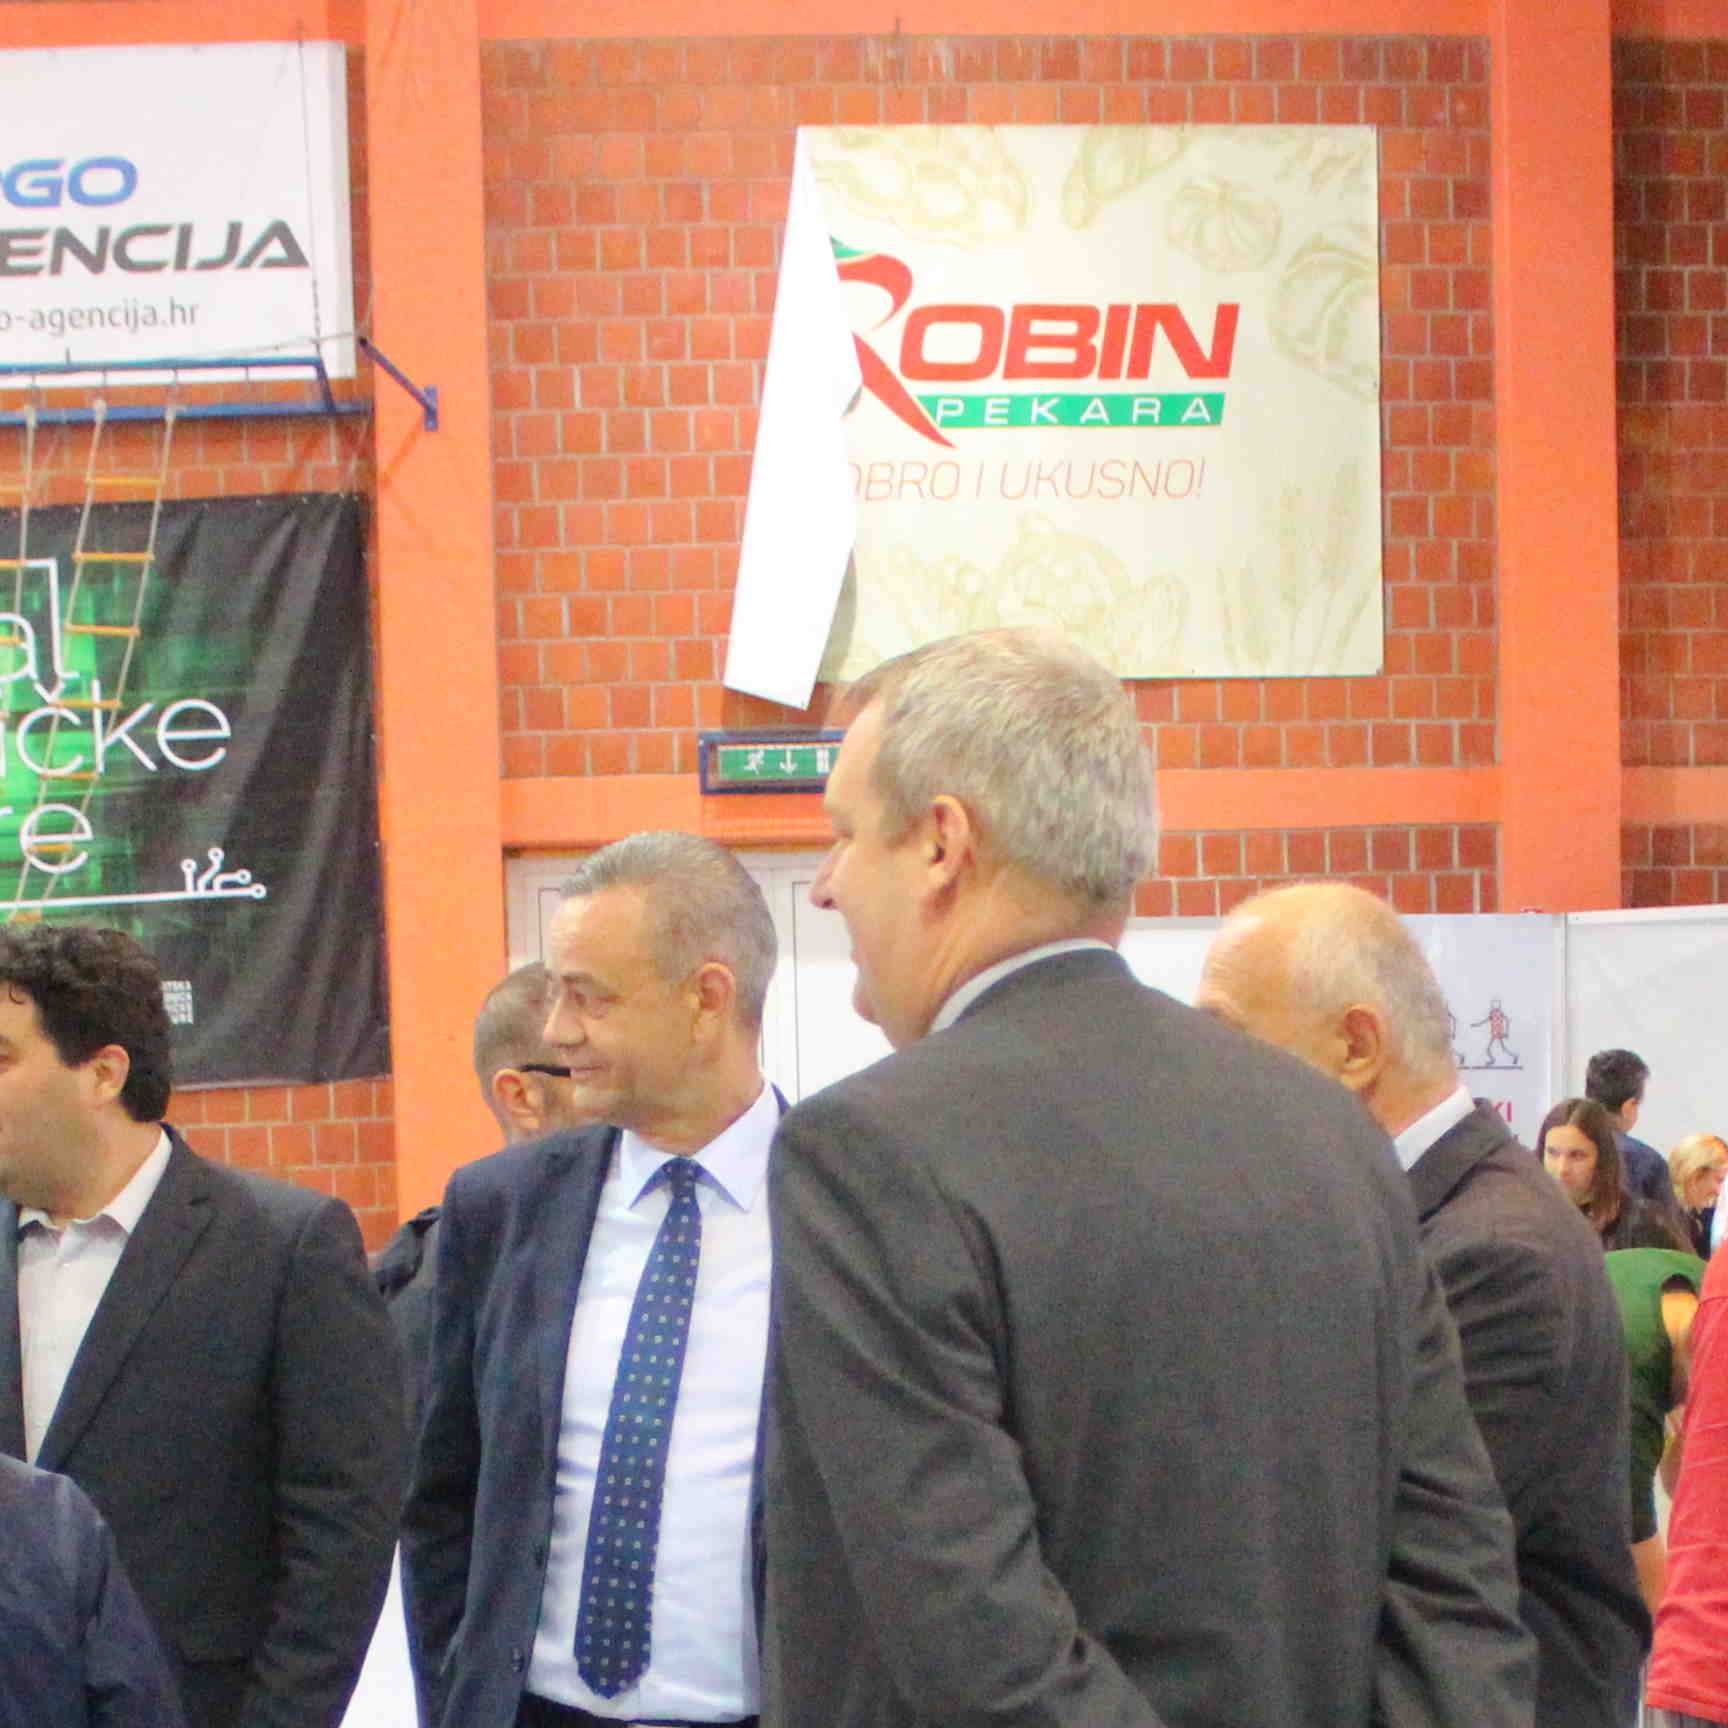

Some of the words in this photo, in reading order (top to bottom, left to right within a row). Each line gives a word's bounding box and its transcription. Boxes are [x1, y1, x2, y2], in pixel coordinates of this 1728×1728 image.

[835, 252, 1241, 450] ROBIN
[935, 397, 1214, 425] PEKARA
[976, 459, 984, 500] I
[999, 456, 1207, 501] UKUSNO!
